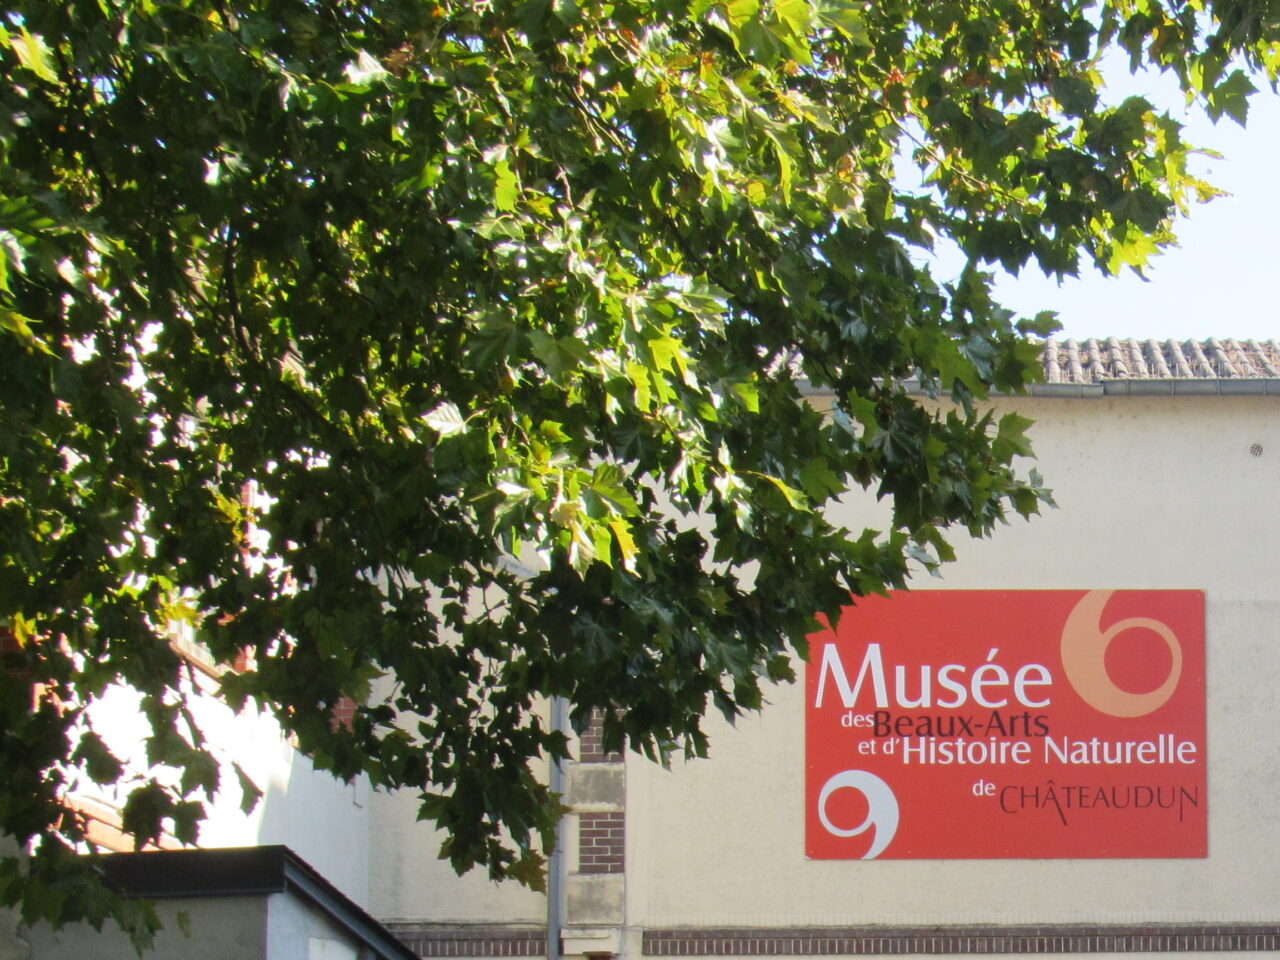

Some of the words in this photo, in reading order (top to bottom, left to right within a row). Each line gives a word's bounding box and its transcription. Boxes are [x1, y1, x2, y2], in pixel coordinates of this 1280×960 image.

[815, 643, 1053, 708] Musée
[841, 711, 874, 728] des
[872, 710, 1050, 737] Beaux-Arts
[858, 740, 876, 755] et
[1044, 734, 1197, 764] Naturelle
[971, 779, 996, 797] de
[1000, 780, 1199, 826] CHÂTEAUDUN
